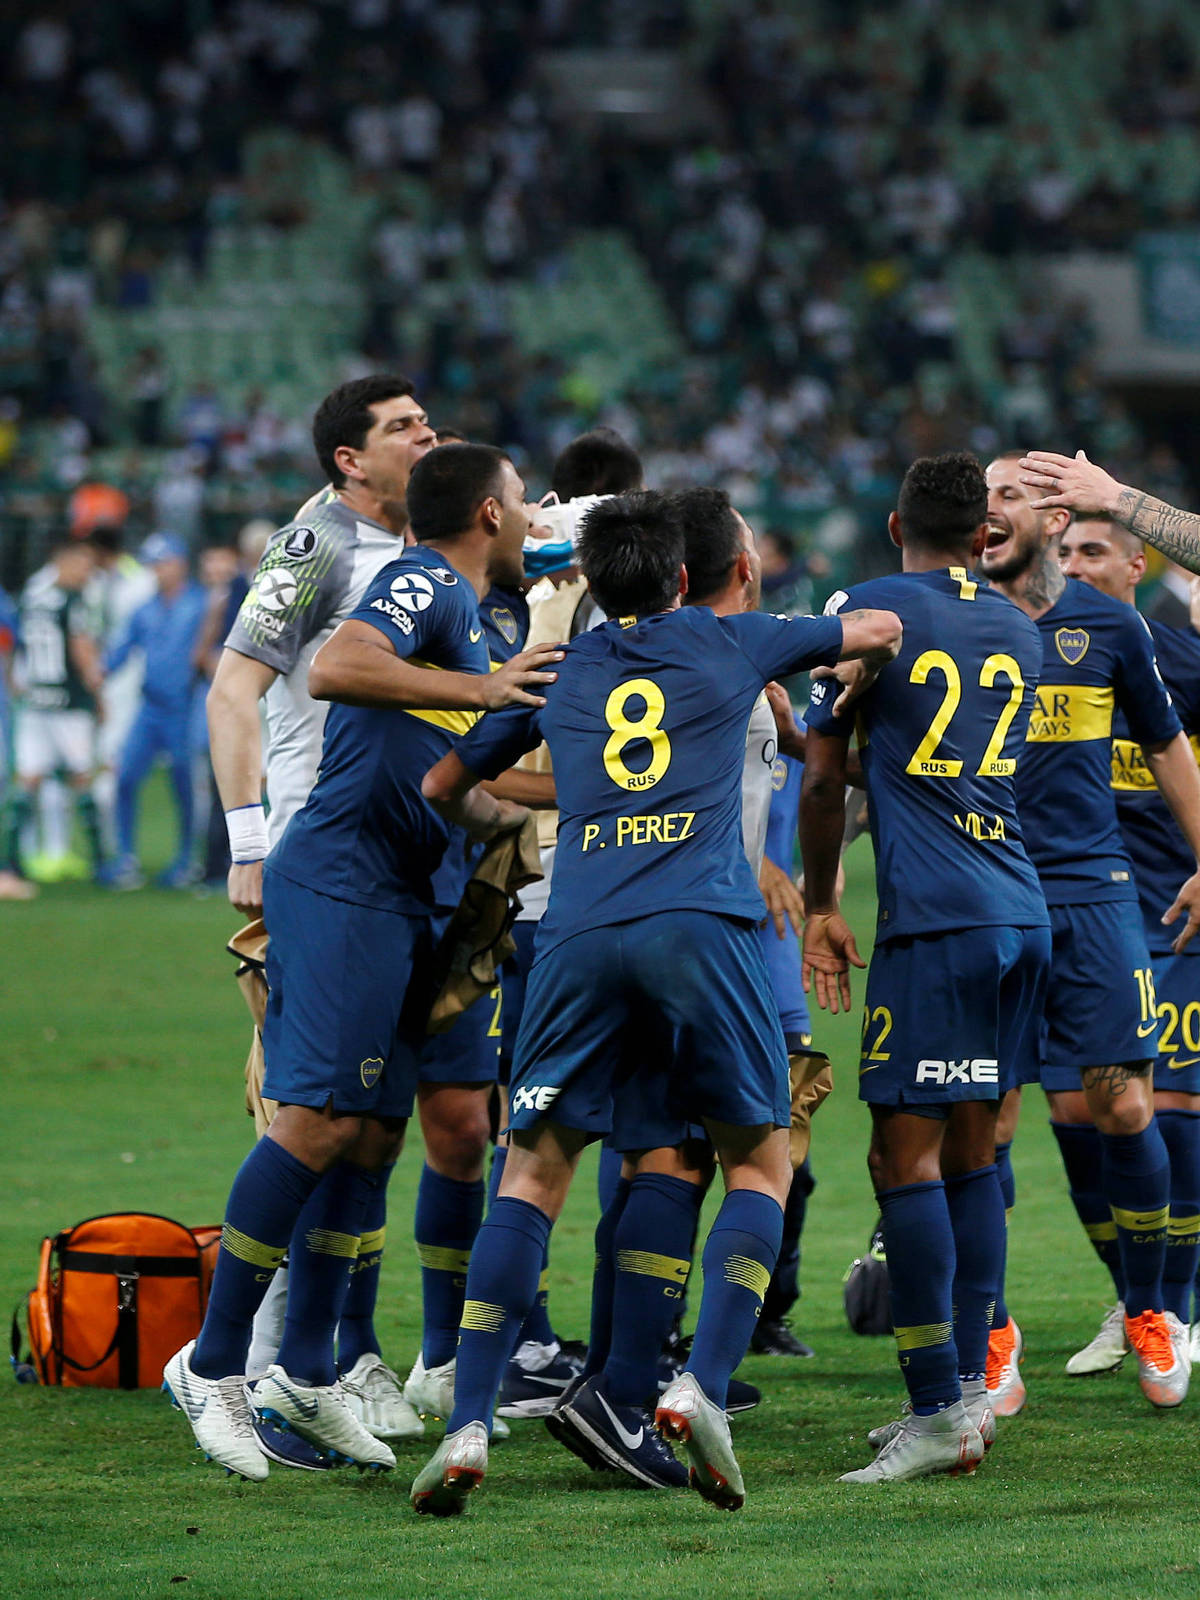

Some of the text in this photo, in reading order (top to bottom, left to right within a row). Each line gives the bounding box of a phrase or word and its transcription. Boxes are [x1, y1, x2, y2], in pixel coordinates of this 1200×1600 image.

[240, 606, 286, 632] AXION
[370, 598, 415, 632] AXION
[905, 649, 1025, 778] 22
[602, 678, 672, 792] 8
[626, 773, 657, 788] RUS
[920, 761, 948, 775] RUS
[989, 761, 1010, 774] RUS
[582, 812, 696, 852] P. PEREZ
[916, 1058, 999, 1085] AXE
